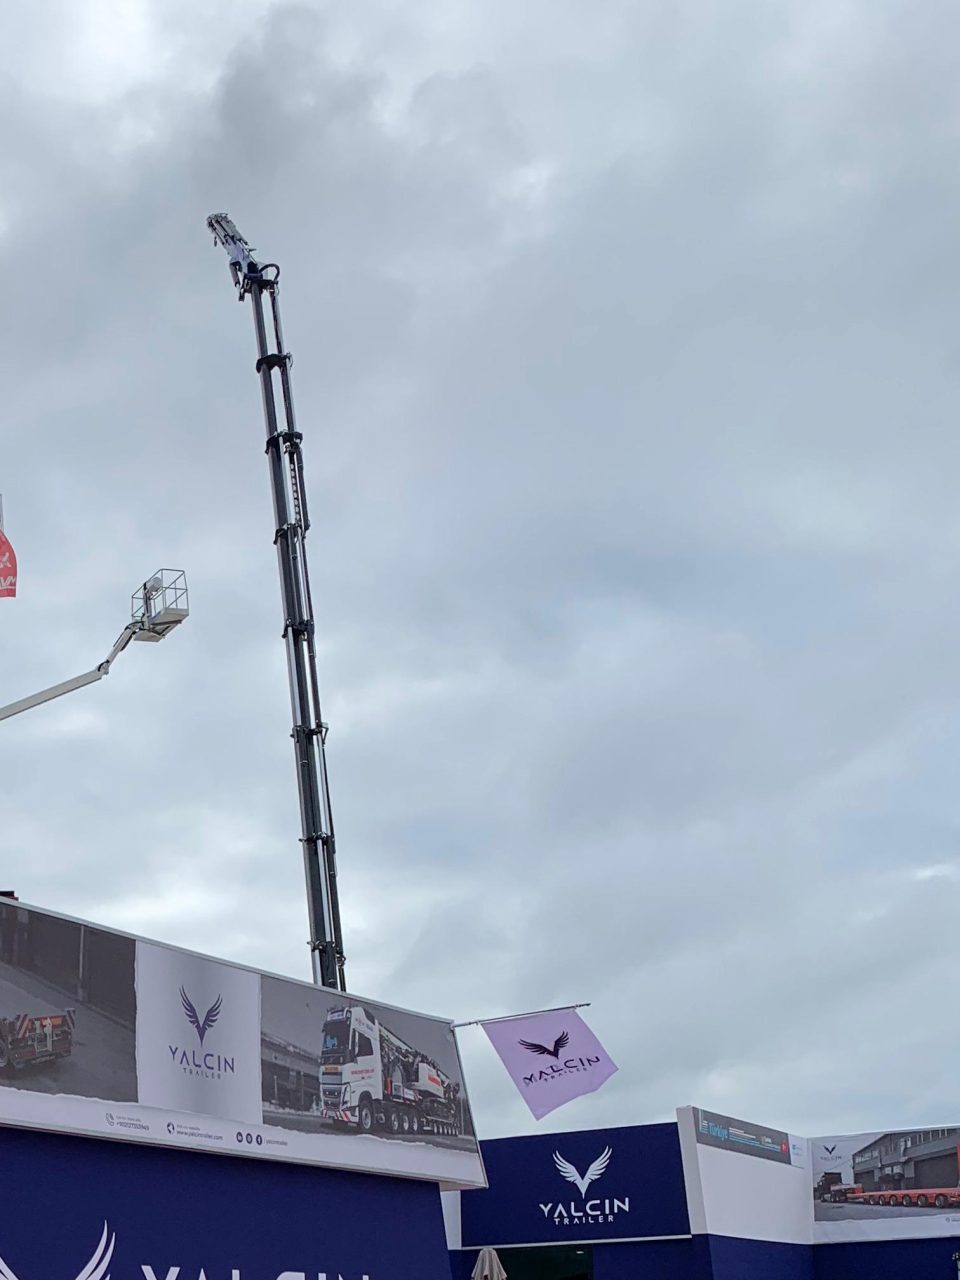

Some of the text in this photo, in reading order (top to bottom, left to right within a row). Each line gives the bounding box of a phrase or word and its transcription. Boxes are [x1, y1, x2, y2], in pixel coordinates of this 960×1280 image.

[168, 1045, 235, 1074] YALCIN
[522, 1056, 600, 1086] YALCIN
[539, 1197, 630, 1219] YALCIN
[554, 1215, 614, 1226] TRAILER
